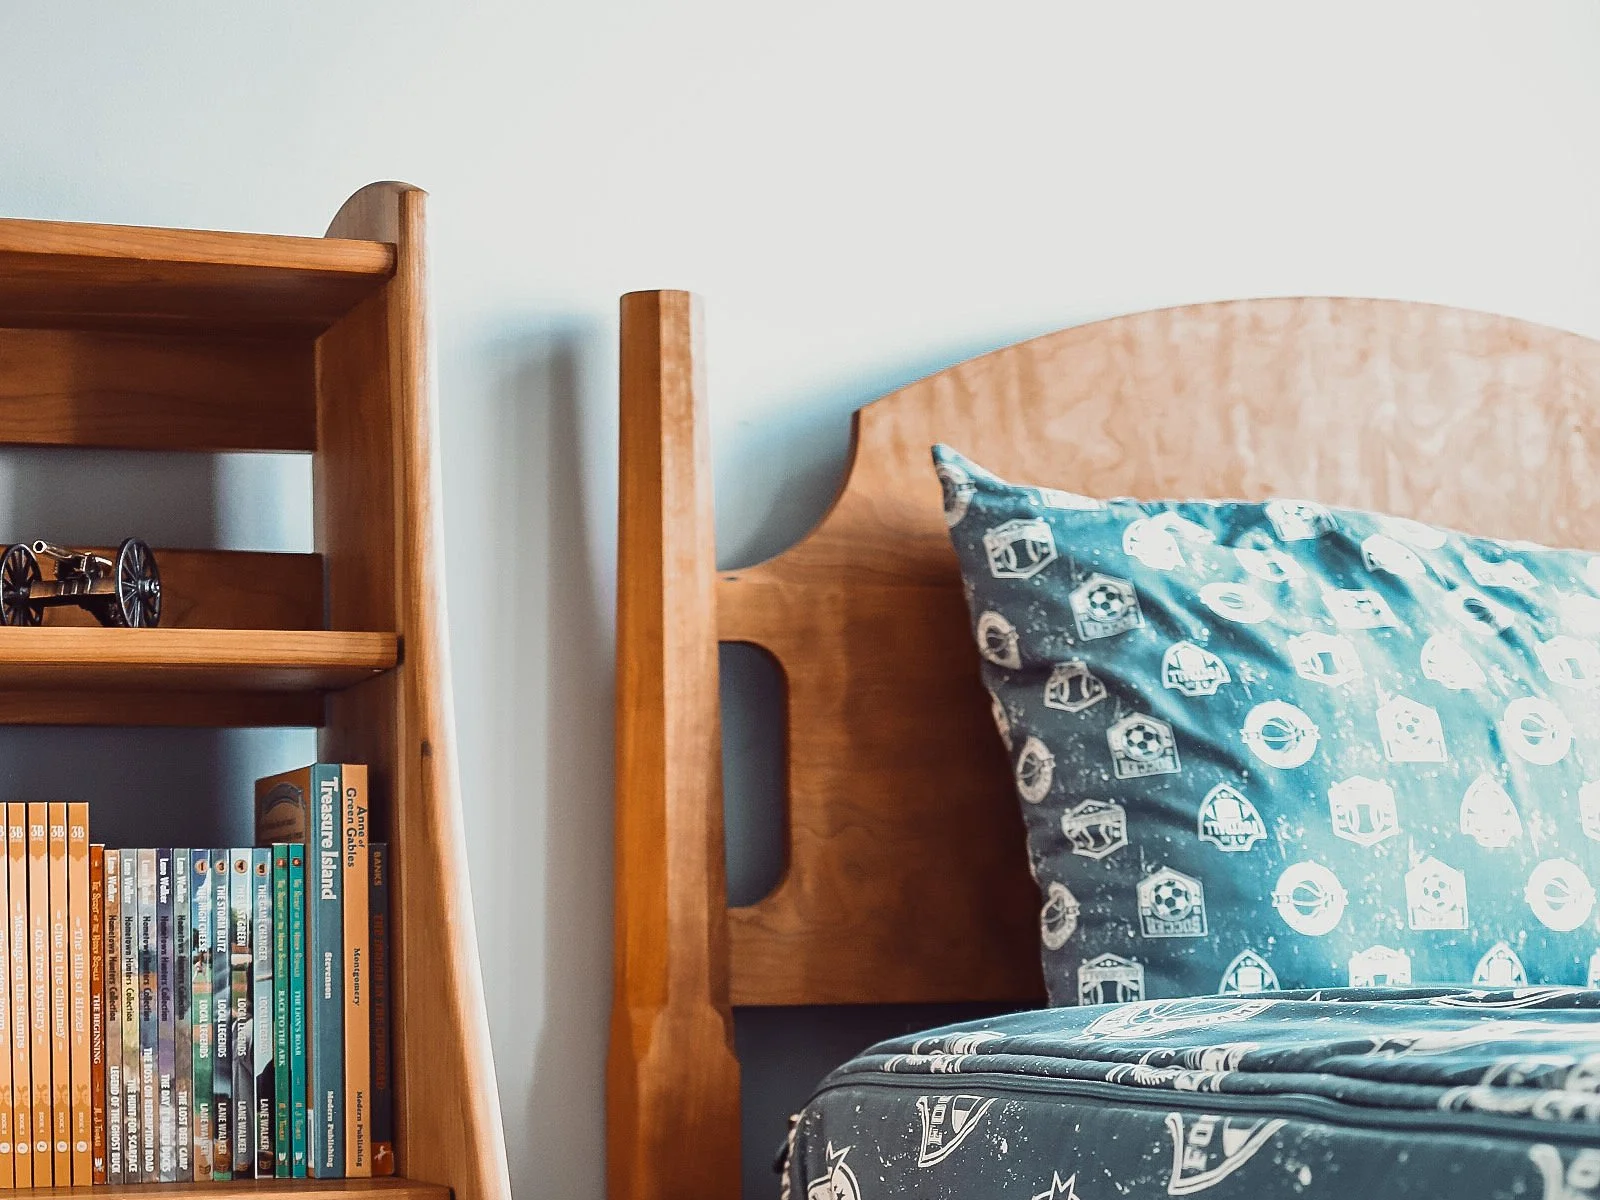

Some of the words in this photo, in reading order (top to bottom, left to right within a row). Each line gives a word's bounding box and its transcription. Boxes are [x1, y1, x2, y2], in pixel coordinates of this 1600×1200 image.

[321, 777, 338, 847] Treasure
[347, 788, 356, 825] Green
[357, 806, 367, 837] Anne
[347, 827, 357, 867] Gables
[358, 839, 365, 848] of
[321, 851, 338, 899] Island
[373, 851, 382, 885] BANKS
[160, 877, 168, 903] Walker
[217, 885, 225, 900] THE
[217, 901, 225, 928] STORM
[13, 915, 26, 963] Message
[34, 929, 45, 950] Oak
[54, 923, 65, 948] Clue
[74, 928, 83, 949] The
[109, 915, 117, 954] Hometown
[125, 917, 133, 955] Hometown
[36, 956, 44, 981] Tree
[56, 952, 64, 962] in
[75, 954, 83, 979] Hills
[109, 956, 117, 985] Hunters
[16, 966, 23, 979] on
[55, 966, 64, 984] the
[125, 958, 134, 985] Hunters
[324, 952, 333, 999] Stevenson
[352, 948, 361, 1006] Montgomery
[16, 984, 24, 1002] the
[76, 982, 84, 994] of
[34, 985, 45, 1033] Mystery
[56, 988, 65, 1039] Chimney
[109, 987, 117, 1021] Collection
[126, 988, 134, 1021] Collection
[218, 1000, 226, 1022] LOCAL
[16, 1006, 25, 1048] Stamps
[278, 1015, 284, 1028] TO
[93, 1013, 101, 1064] BEGINNING
[218, 1024, 226, 1057] LEGENDS
[111, 1066, 119, 1094] LEGEND
[111, 1097, 119, 1107] OF
[111, 1109, 119, 1123] THE
[127, 1095, 136, 1116] HUNT
[238, 1101, 246, 1121] LANE
[260, 1099, 268, 1118] LANE
[327, 1091, 335, 1121] Modern
[356, 1091, 364, 1121] Modern
[111, 1125, 120, 1150] GHOST
[128, 1118, 136, 1133] FOR
[238, 1122, 246, 1153] WALKER
[260, 1119, 269, 1150] WALKER
[325, 1123, 335, 1167] Publishing
[355, 1124, 364, 1167] Publishing
[111, 1153, 120, 1173] BUCK
